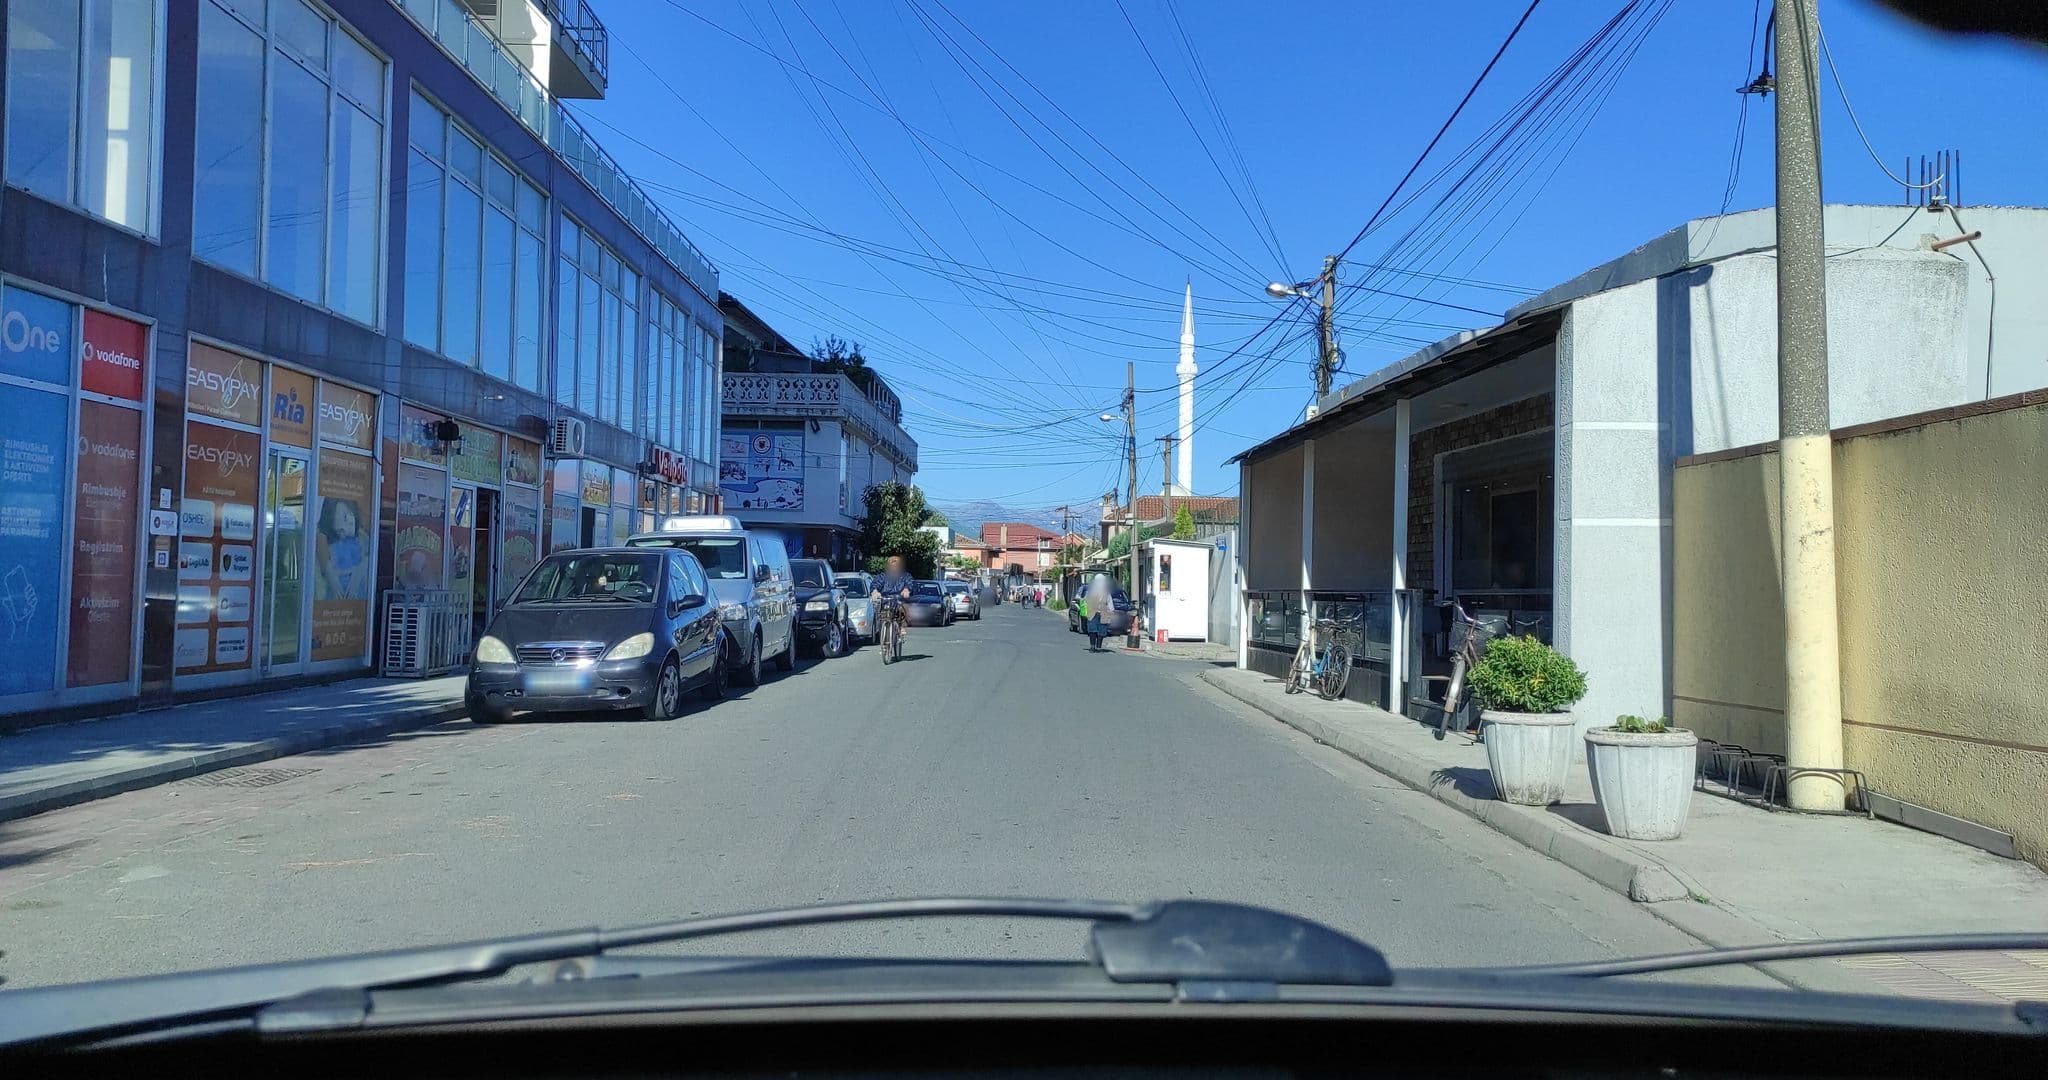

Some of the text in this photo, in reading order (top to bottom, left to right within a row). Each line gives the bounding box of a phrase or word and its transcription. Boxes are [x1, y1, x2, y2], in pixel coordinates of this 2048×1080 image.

[2, 311, 60, 353] One
[96, 349, 140, 370] vodafone
[187, 367, 261, 401] EASYPAY
[274, 386, 305, 425] Ria
[320, 402, 373, 428] EASYPAY
[91, 442, 136, 460] vodafone
[187, 445, 252, 468] EASYPAY
[82, 483, 127, 500] Rimbushje
[182, 512, 205, 525] OSHEE
[80, 540, 124, 555] Regjistrim
